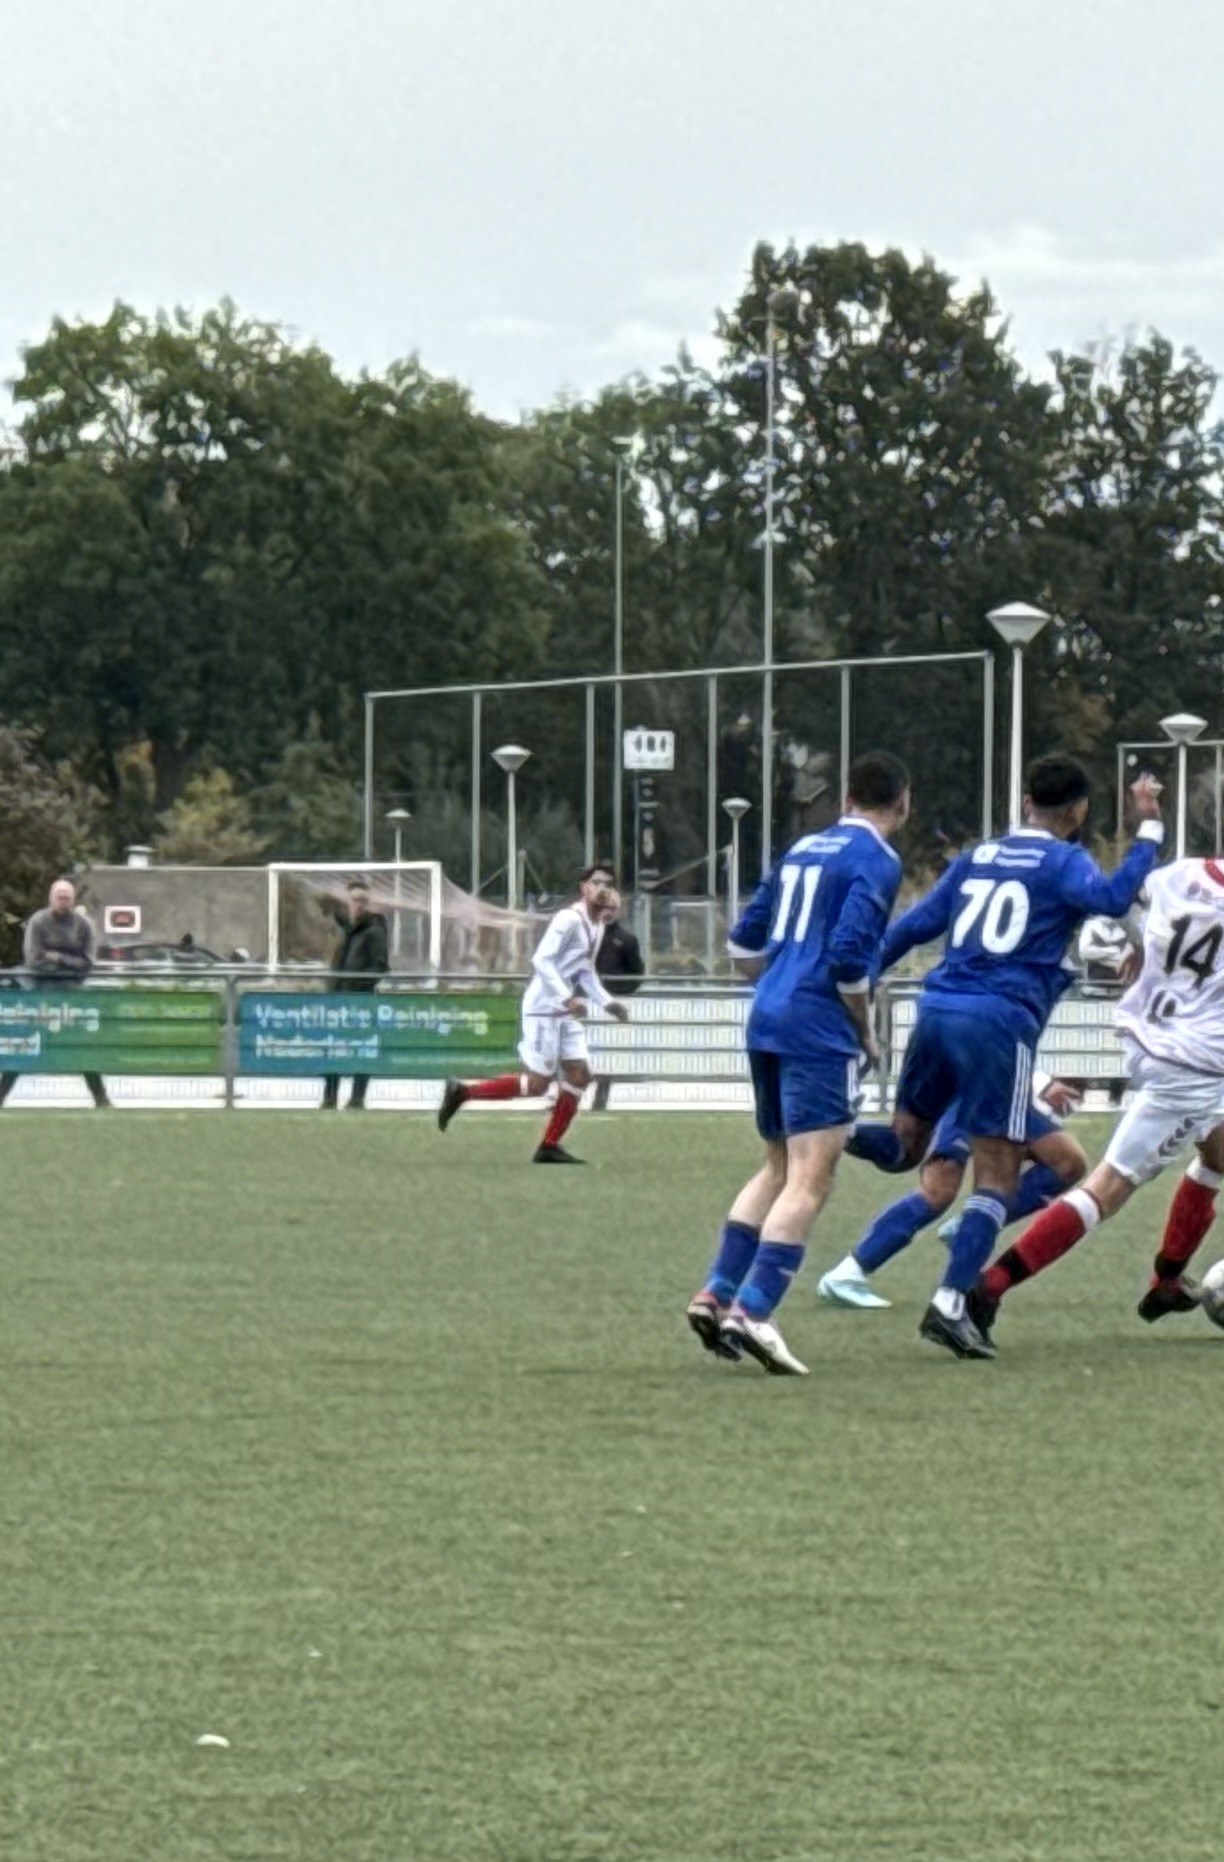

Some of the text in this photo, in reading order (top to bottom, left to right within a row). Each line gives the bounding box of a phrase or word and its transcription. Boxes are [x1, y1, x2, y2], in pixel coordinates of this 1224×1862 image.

[770, 864, 824, 943] 11
[951, 878, 1031, 955] 70
[1163, 912, 1224, 990] 14
